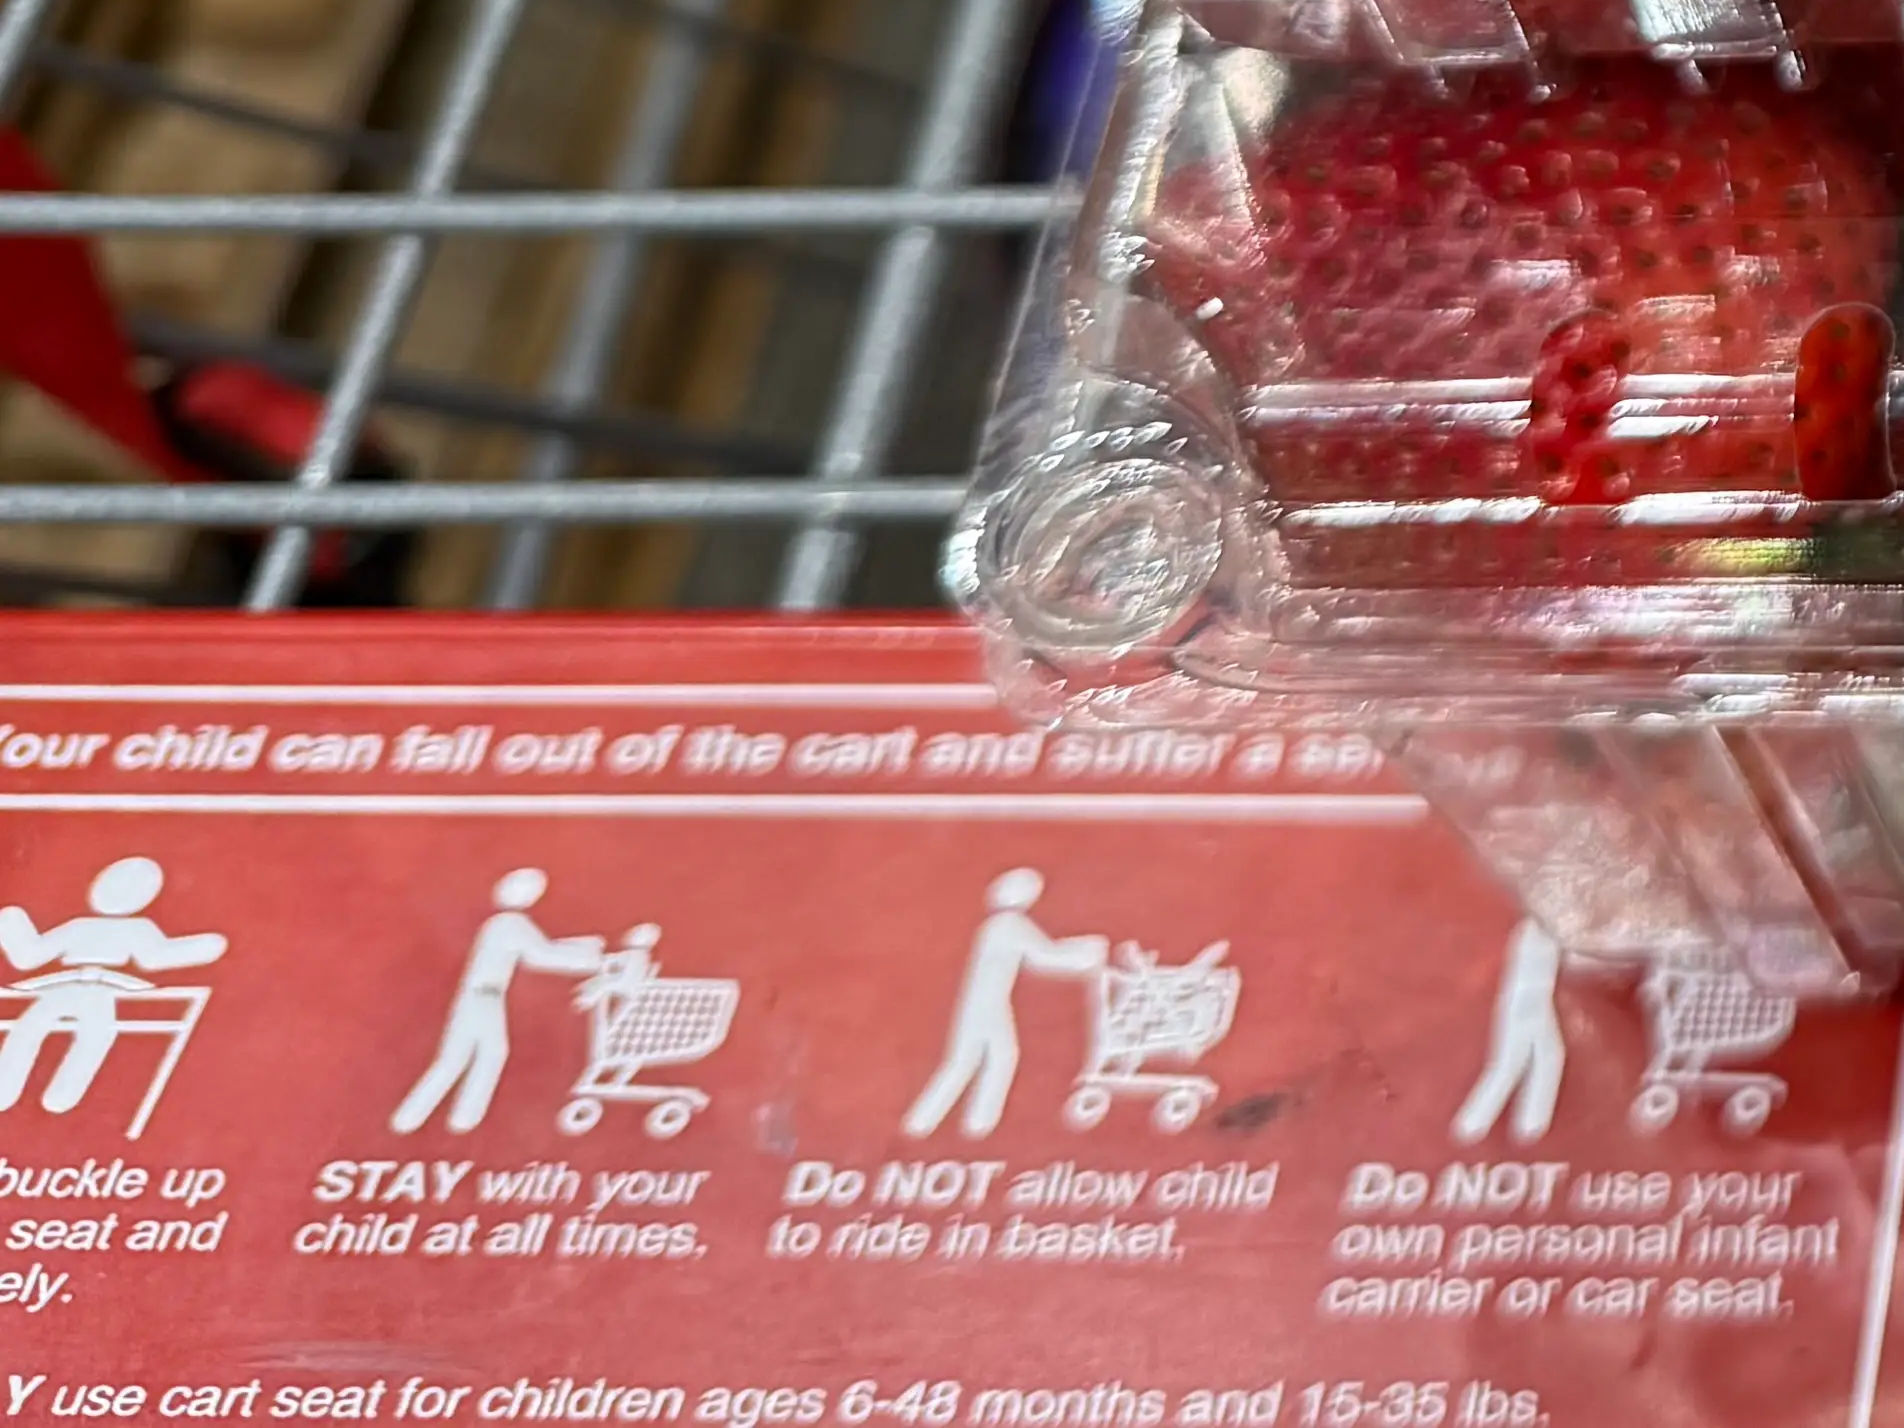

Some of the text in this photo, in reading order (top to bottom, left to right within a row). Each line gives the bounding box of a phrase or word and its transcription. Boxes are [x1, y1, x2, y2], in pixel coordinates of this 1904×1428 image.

[114, 721, 269, 772] child
[271, 732, 383, 773] can
[394, 723, 495, 774] fall
[500, 727, 603, 775] out
[606, 722, 688, 776] of
[680, 723, 785, 776] the
[790, 726, 919, 777] cart
[921, 727, 1043, 778] and
[159, 1166, 227, 1209] up
[312, 1159, 710, 1219] STAY with your
[784, 1159, 1280, 1212] Do NOT allow child
[1341, 1160, 1801, 1221] Do NOT use your
[5, 1211, 229, 1252] seat and
[291, 1212, 708, 1258] child at all times.
[766, 1214, 821, 1259] to
[828, 1212, 931, 1260] ride
[935, 1213, 990, 1260] in
[1330, 1214, 1840, 1274] own personal infant
[1317, 1268, 1496, 1319] carrier
[1497, 1274, 1563, 1319] or
[1564, 1274, 1659, 1319] car
[51, 1382, 148, 1418] use
[157, 1377, 261, 1419] cart
[269, 1377, 387, 1420] seat
[392, 1375, 472, 1420] for
[477, 1377, 690, 1422] children
[698, 1385, 828, 1428] ages
[835, 1379, 961, 1425] 6-48
[968, 1379, 1165, 1426] months
[1175, 1380, 1285, 1426] and
[1298, 1379, 1450, 1427] 15-35
